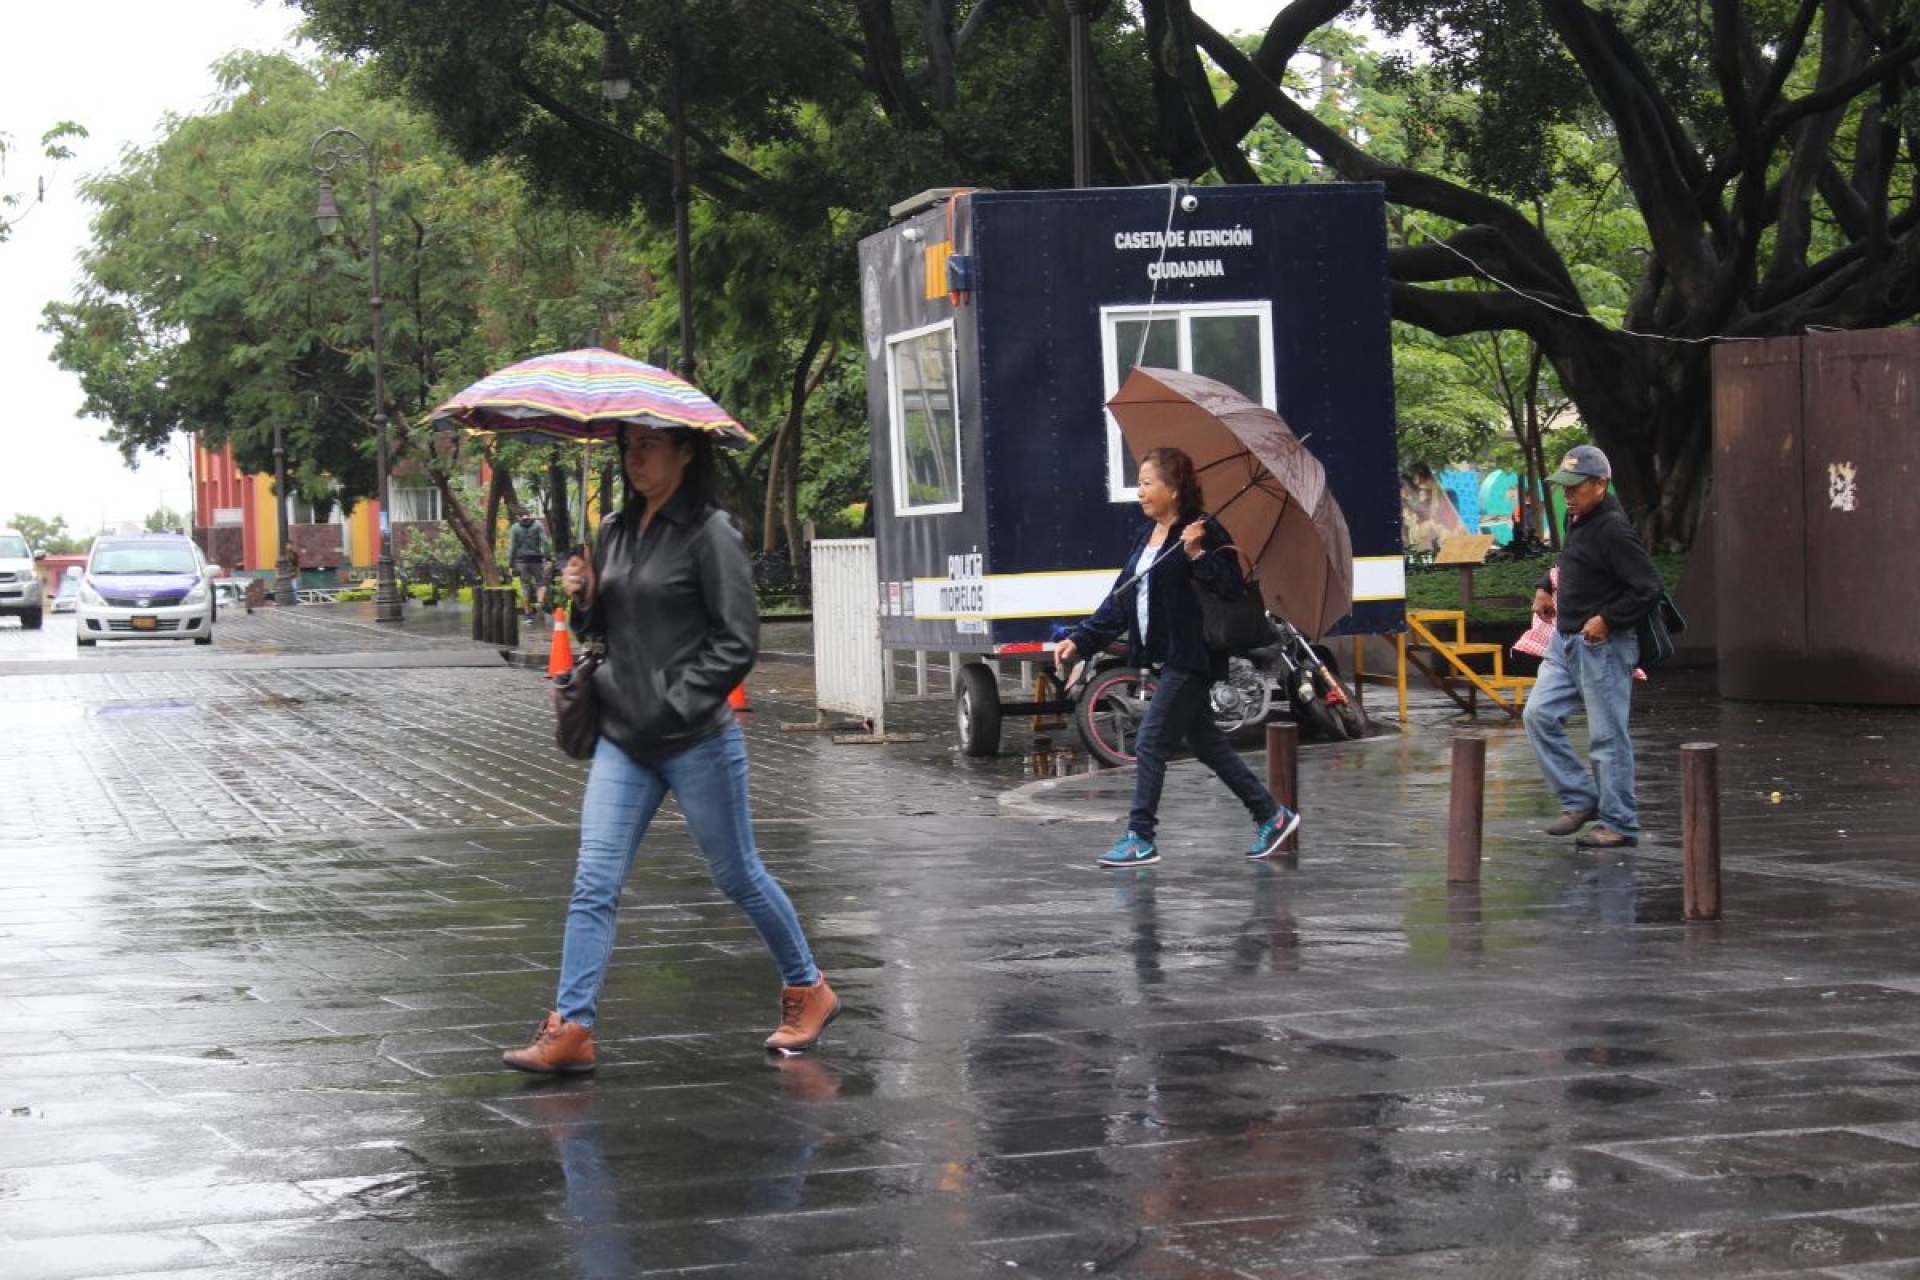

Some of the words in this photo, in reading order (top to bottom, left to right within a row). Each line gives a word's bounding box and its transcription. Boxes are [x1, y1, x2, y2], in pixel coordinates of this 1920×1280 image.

[1114, 231, 1166, 249] CASETA
[1167, 229, 1185, 247] DE
[1189, 223, 1253, 247] ATENCIÓN
[1147, 259, 1224, 279] CIUDADANA
[940, 586, 983, 612] MORELOS
